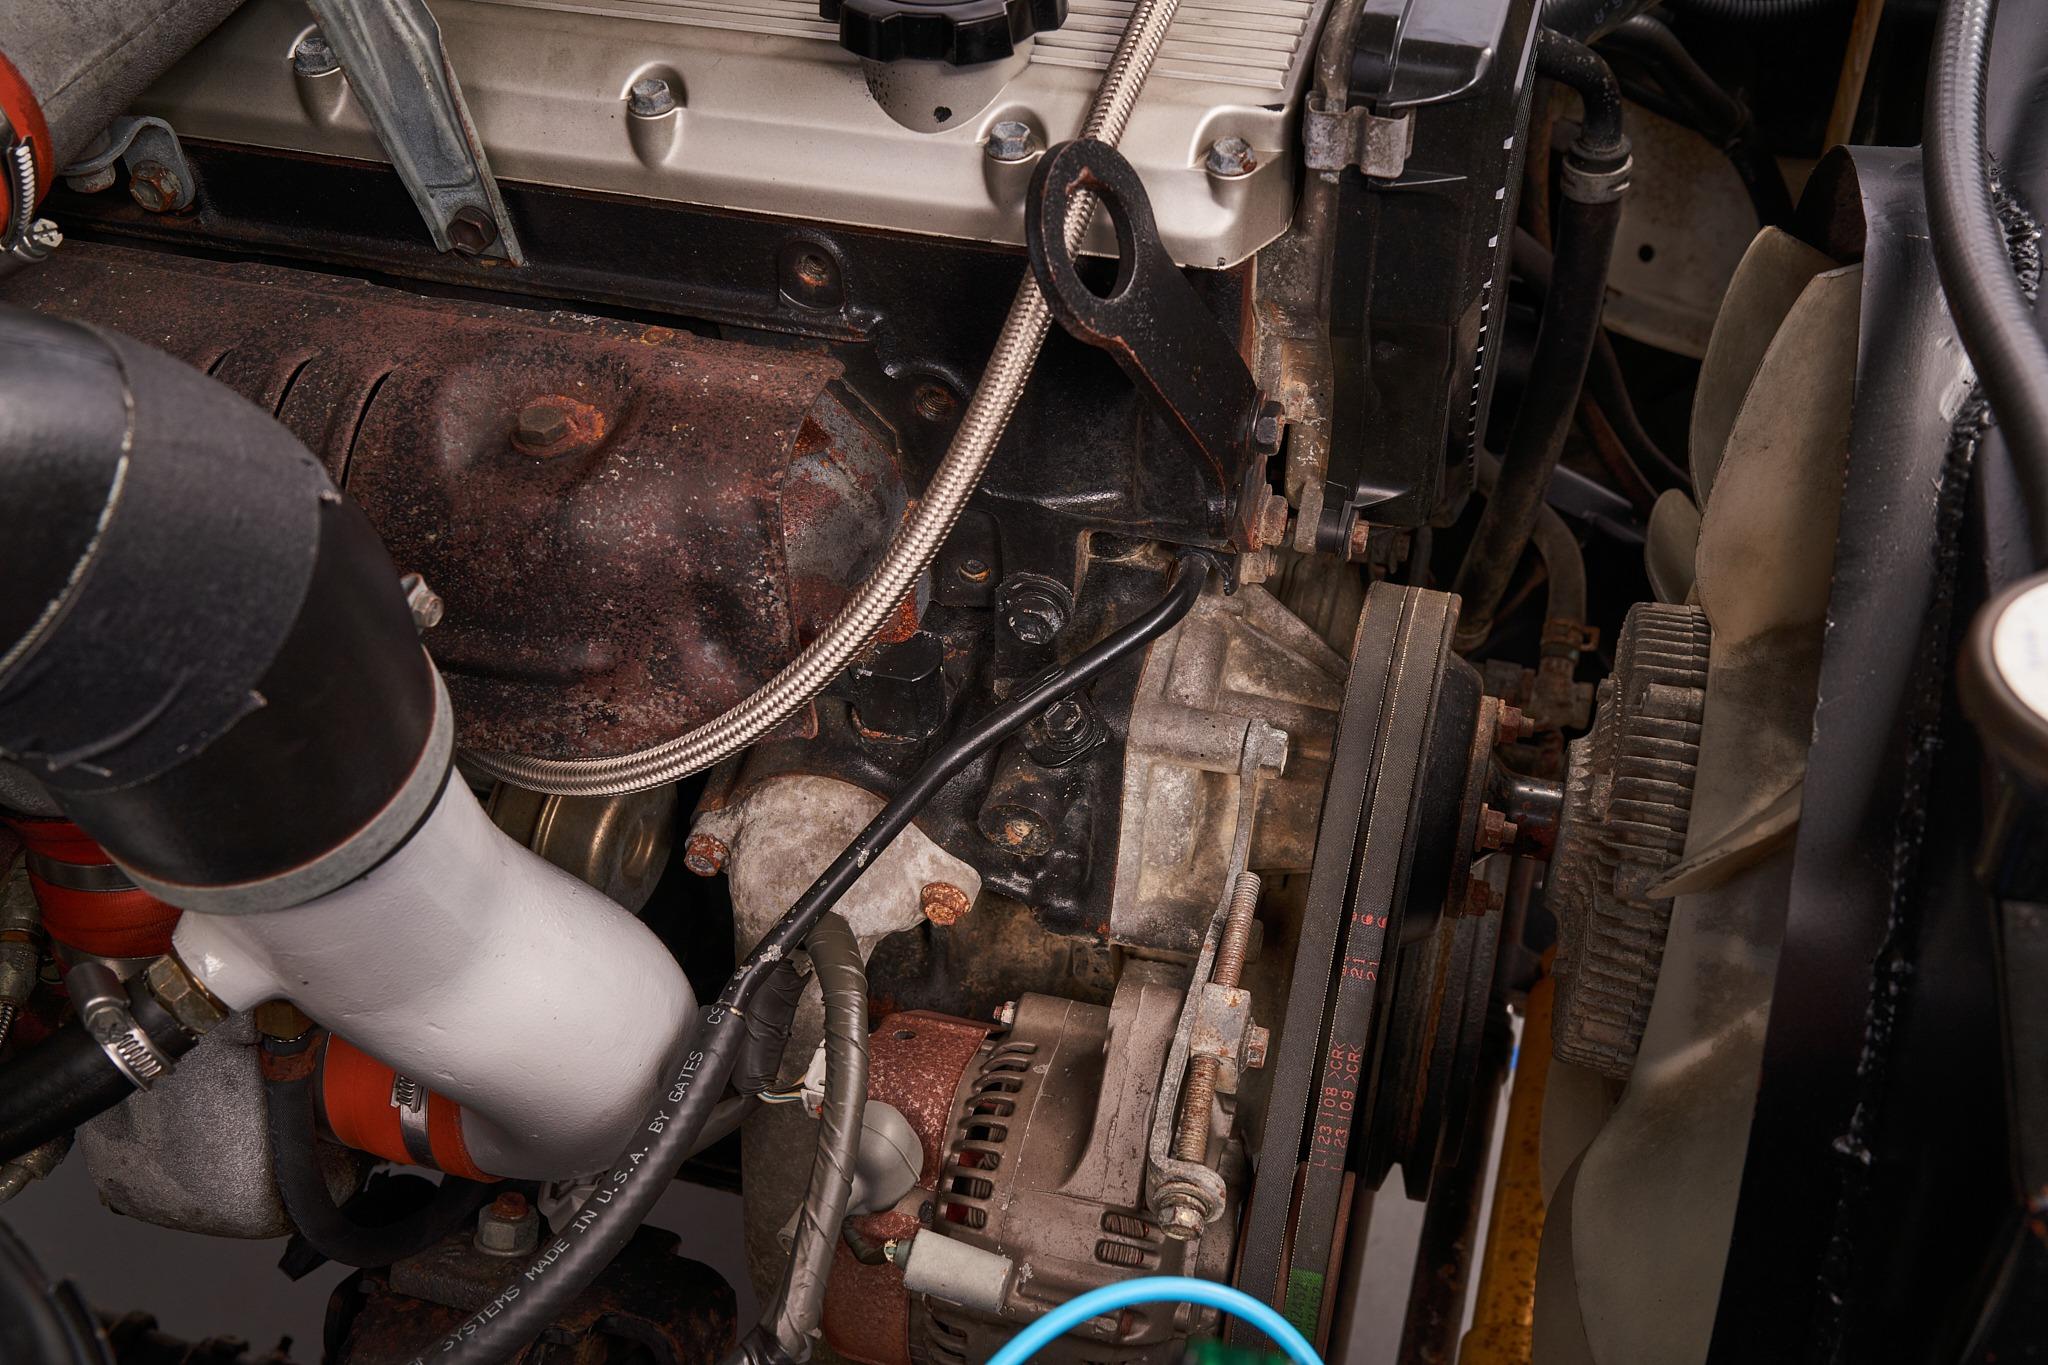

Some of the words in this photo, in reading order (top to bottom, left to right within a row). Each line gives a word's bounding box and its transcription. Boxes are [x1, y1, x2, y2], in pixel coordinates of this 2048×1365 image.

[443, 1285, 520, 1351] SYSTEMS
[525, 1238, 570, 1281] MADE
[572, 1209, 598, 1233] IN
[597, 1147, 648, 1204] U.S.A.
[648, 1110, 669, 1133] BY
[669, 1050, 704, 1102] GATES
